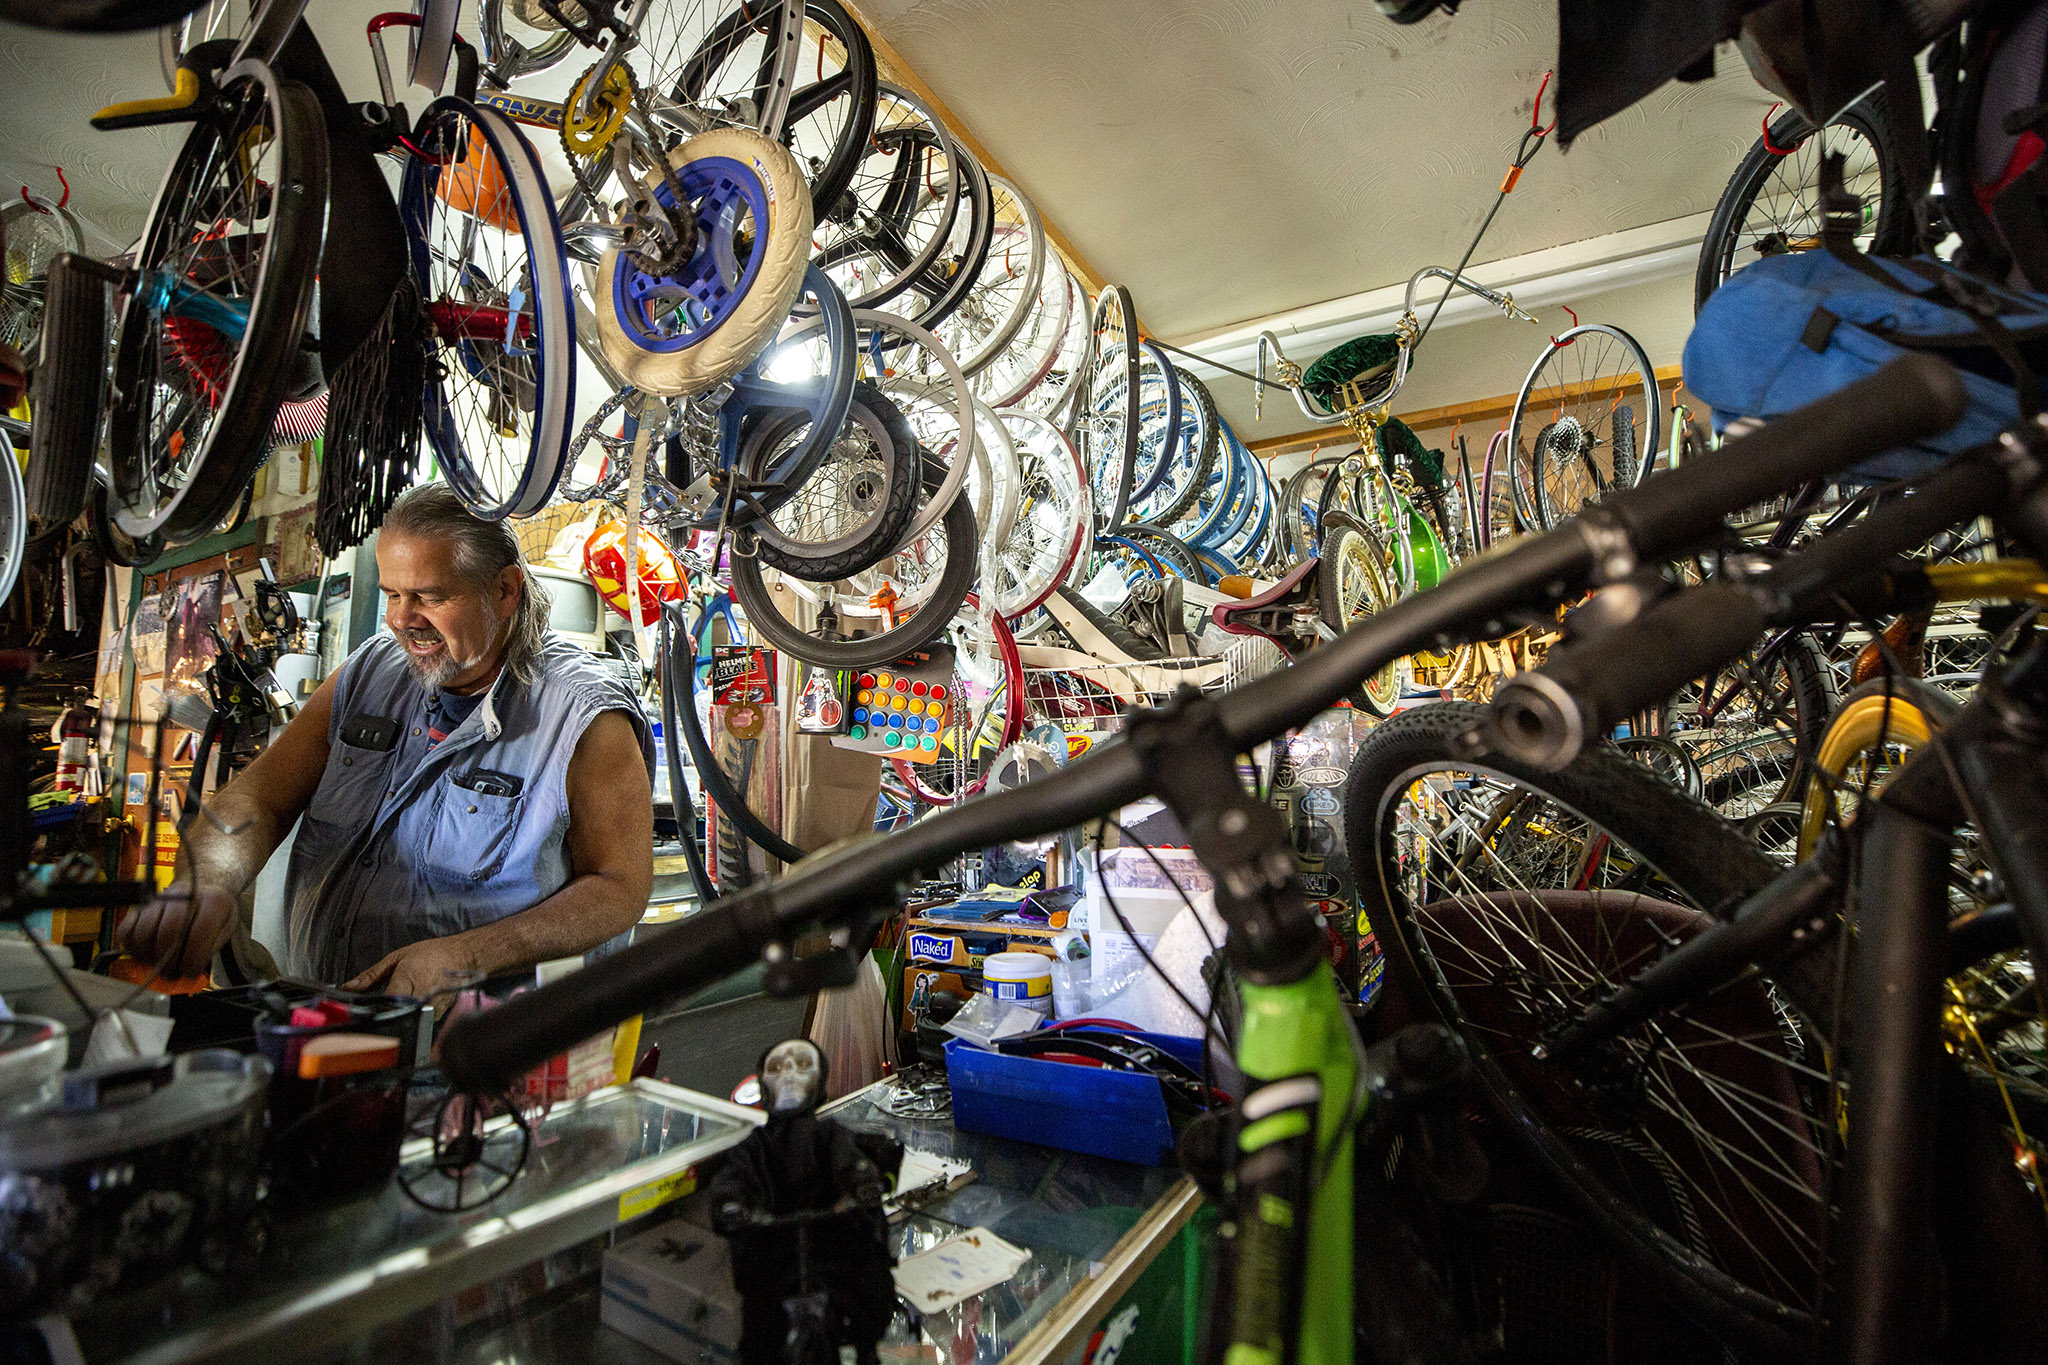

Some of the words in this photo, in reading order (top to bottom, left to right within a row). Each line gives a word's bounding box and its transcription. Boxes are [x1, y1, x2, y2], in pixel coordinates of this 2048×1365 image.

[758, 163, 776, 202] MICHELIN
[631, 461, 642, 499] FOND
[629, 511, 638, 529] DE
[629, 540, 638, 588] JANTE
[1019, 870, 1041, 889] slap
[915, 938, 948, 957] Naked
